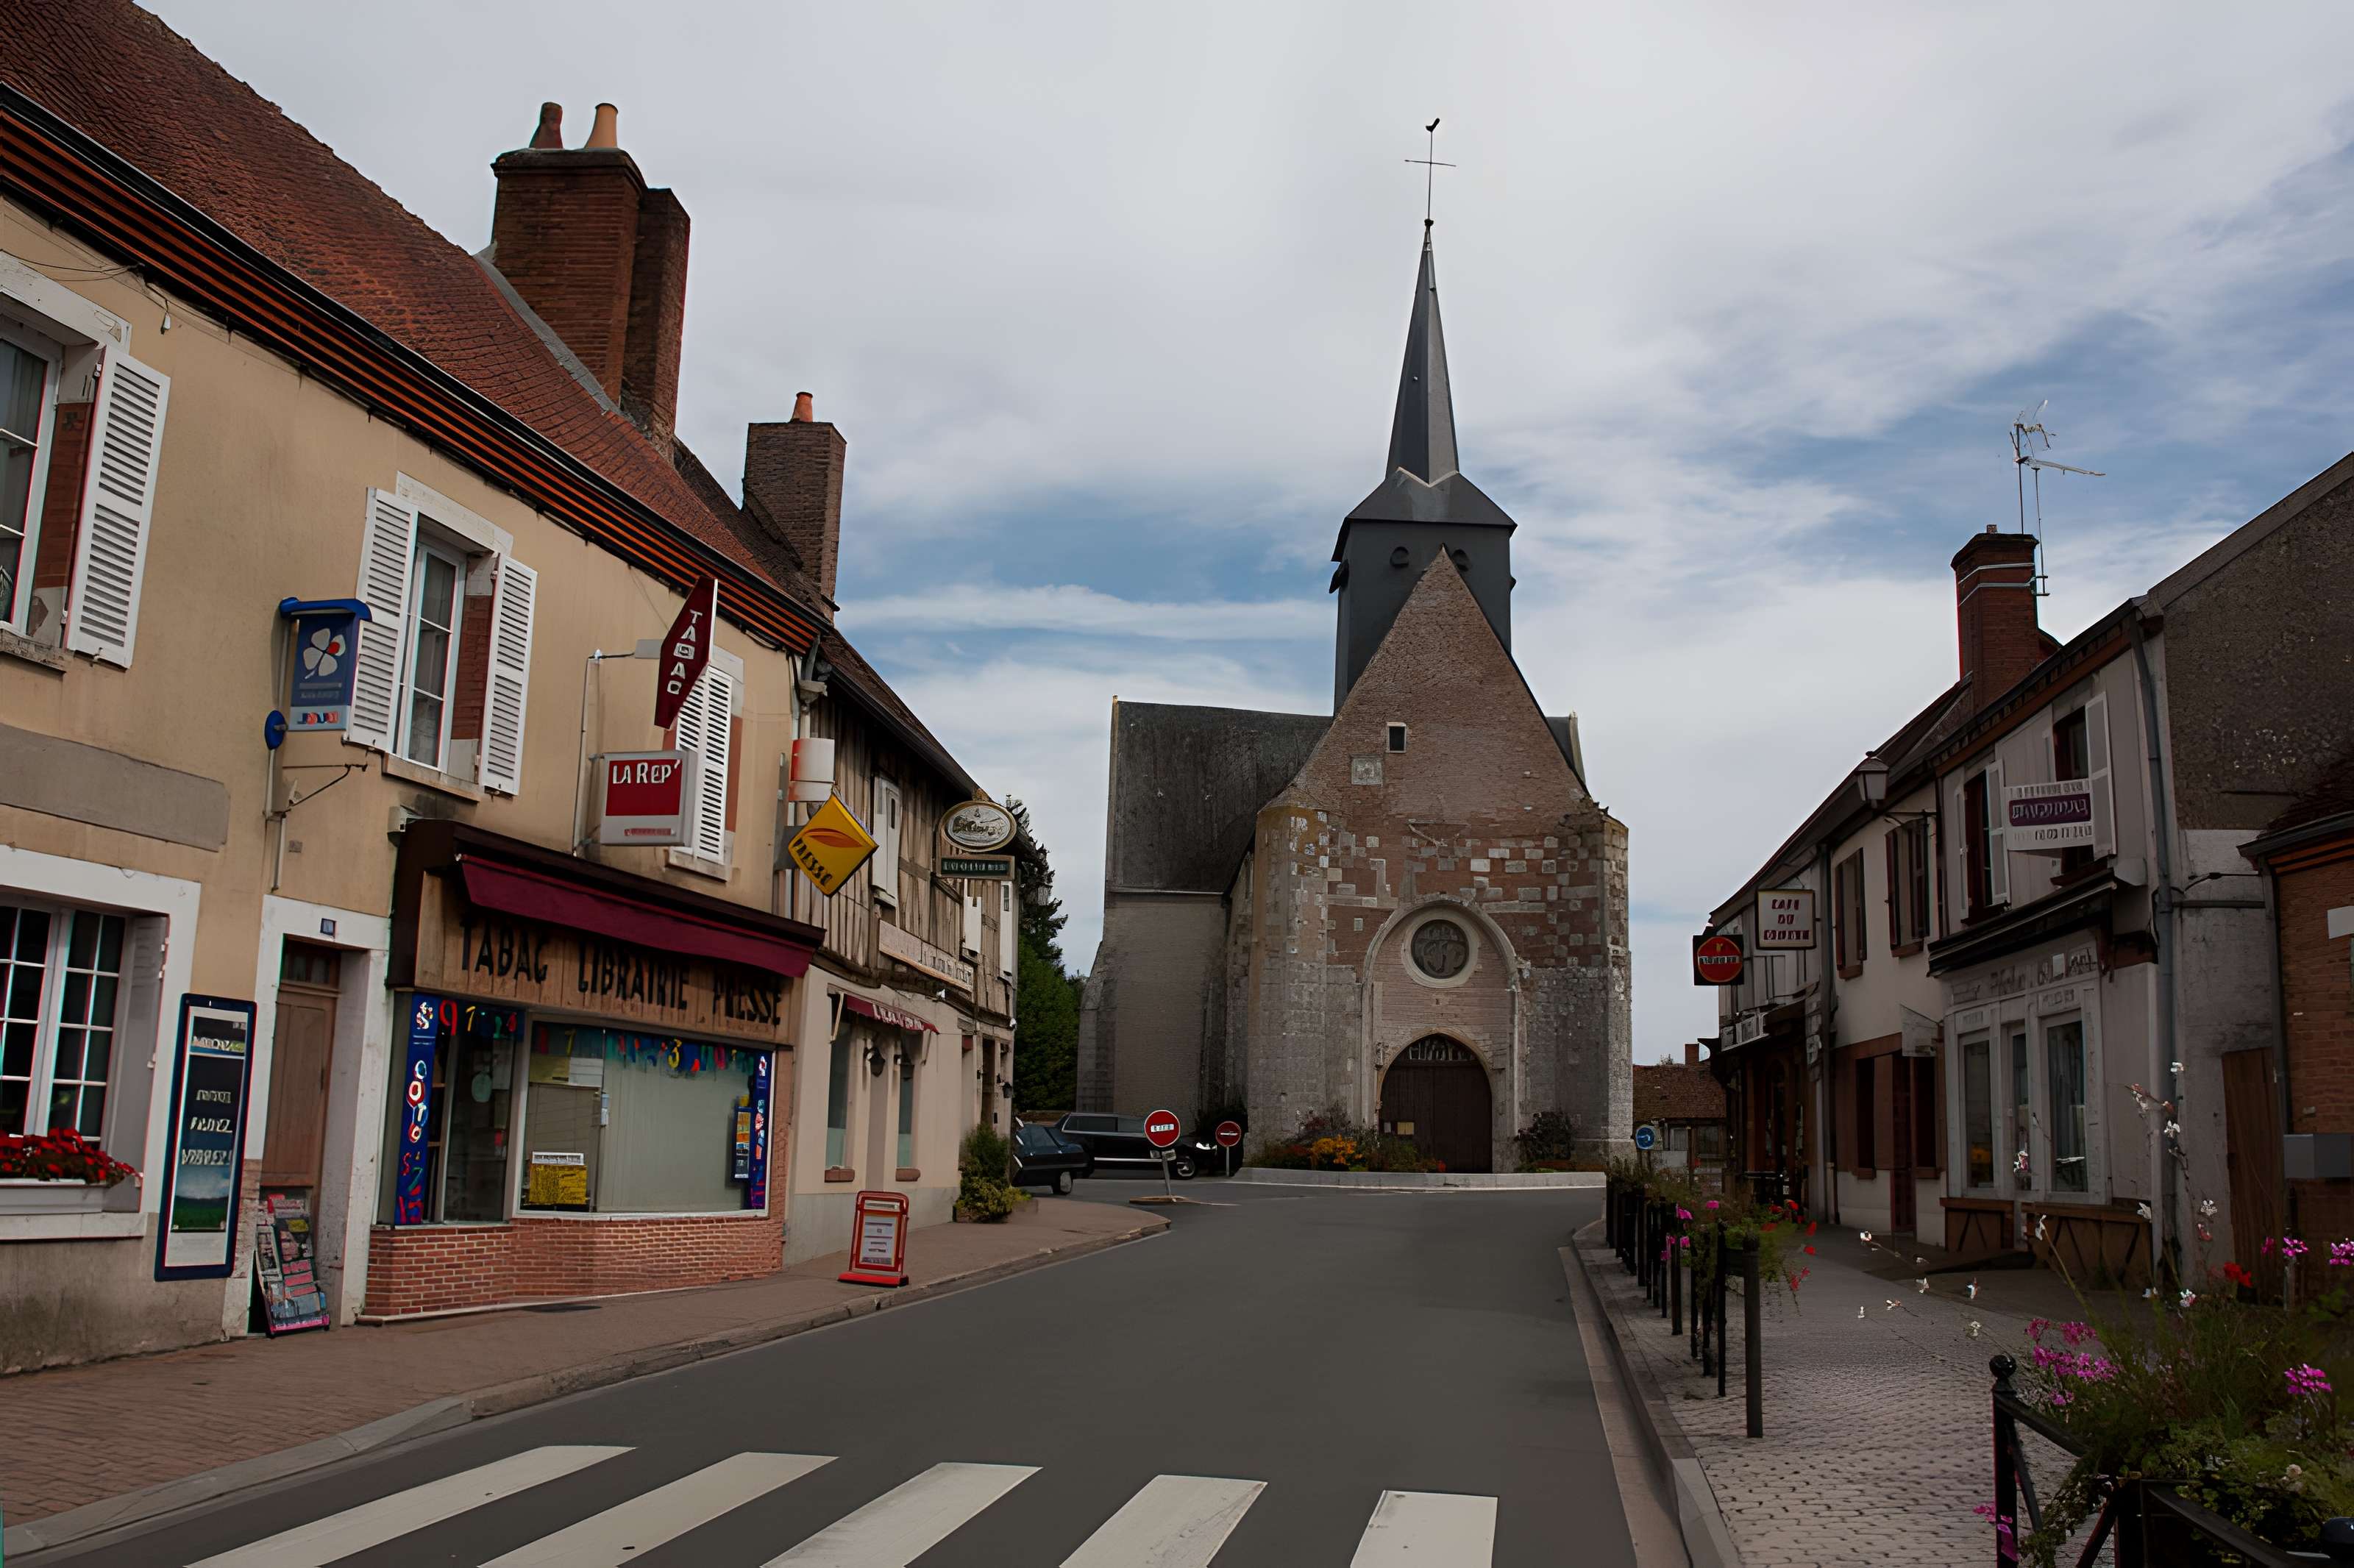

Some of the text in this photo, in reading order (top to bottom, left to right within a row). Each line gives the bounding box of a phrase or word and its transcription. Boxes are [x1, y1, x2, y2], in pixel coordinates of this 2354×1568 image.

[612, 763, 632, 785] LA
[460, 918, 548, 983] TABAC
[579, 939, 690, 1011] LIBRAIRIE
